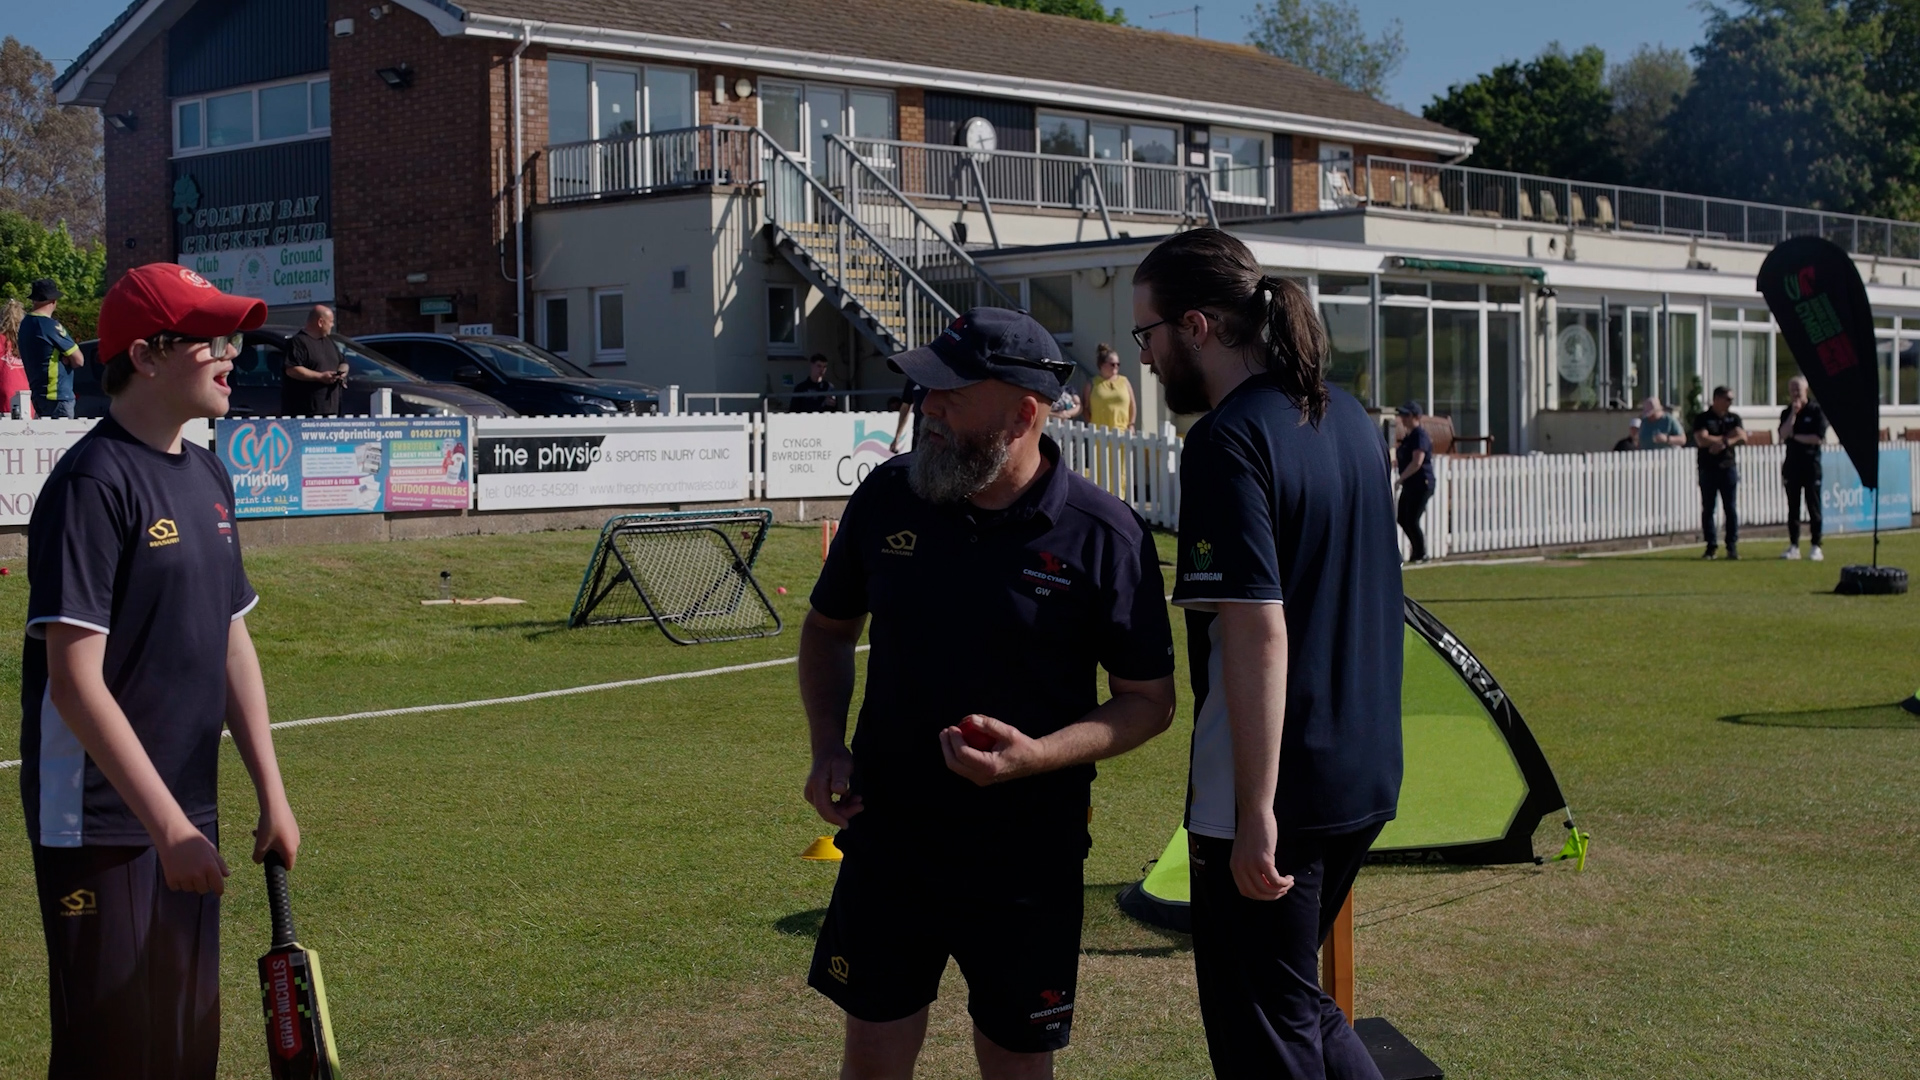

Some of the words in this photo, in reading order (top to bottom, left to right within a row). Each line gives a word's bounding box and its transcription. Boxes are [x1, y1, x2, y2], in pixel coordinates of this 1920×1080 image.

[195, 202, 273, 228] COLWYN
[278, 196, 319, 220] BAY
[183, 228, 269, 253] CRICKET
[273, 222, 327, 245] CLUB
[280, 245, 323, 266] Ground
[196, 255, 219, 274] Club
[273, 268, 330, 287] Centenary
[301, 428, 403, 442] www.cydprinting.com
[410, 429, 433, 438] 01492
[434, 428, 462, 438] 877119
[782, 438, 822, 449] CYNGOR
[494, 444, 528, 466] the
[538, 441, 602, 470] physio
[606, 450, 613, 463] &
[616, 450, 657, 463] SPORTS
[661, 449, 697, 462] INJURY
[699, 448, 731, 461] CLINIC
[772, 451, 832, 462] BWRDEISTREF
[789, 463, 815, 474] SIROL
[233, 470, 289, 493] printing
[391, 484, 430, 495] OUTDOOR
[430, 485, 467, 497] BANNERS
[504, 483, 579, 499] 01492-545291
[1832, 482, 1864, 514] Sport
[881, 547, 913, 557] MASURI
[1022, 568, 1047, 580] CRICED
[1046, 574, 1072, 586] CYMRU
[1183, 572, 1223, 582] GLAMORGAN
[1035, 586, 1052, 597] GW
[1438, 631, 1505, 711] FORZA
[1365, 850, 1445, 863] ORZA
[1046, 1022, 1060, 1031] GW
